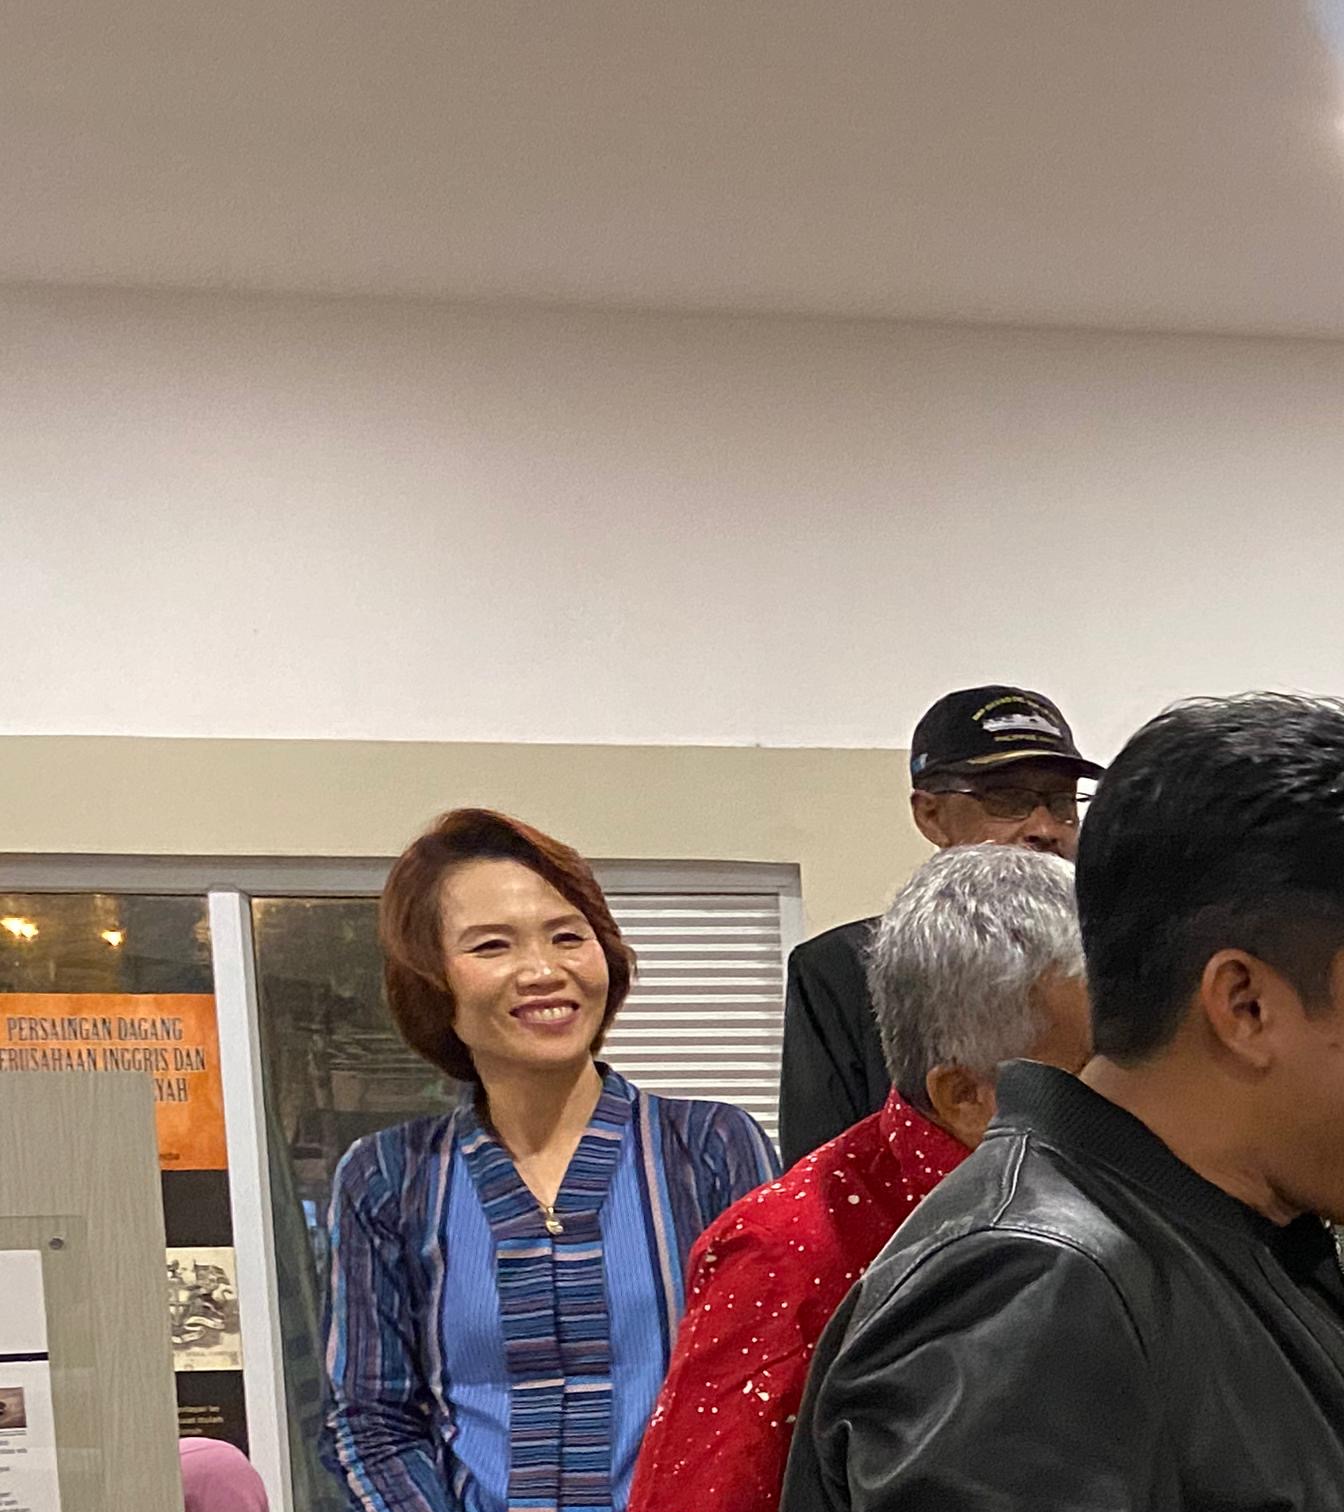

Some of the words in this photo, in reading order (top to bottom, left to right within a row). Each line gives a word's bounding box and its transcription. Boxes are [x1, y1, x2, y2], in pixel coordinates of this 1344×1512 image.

[6, 1017, 112, 1041] PERSAINGAN
[118, 1017, 183, 1041] DAGANG
[0, 1048, 97, 1071] ERUSAHAAN
[104, 1048, 168, 1071] INGGRIS
[174, 1048, 206, 1071] DAN
[154, 1078, 188, 1102] YAH
